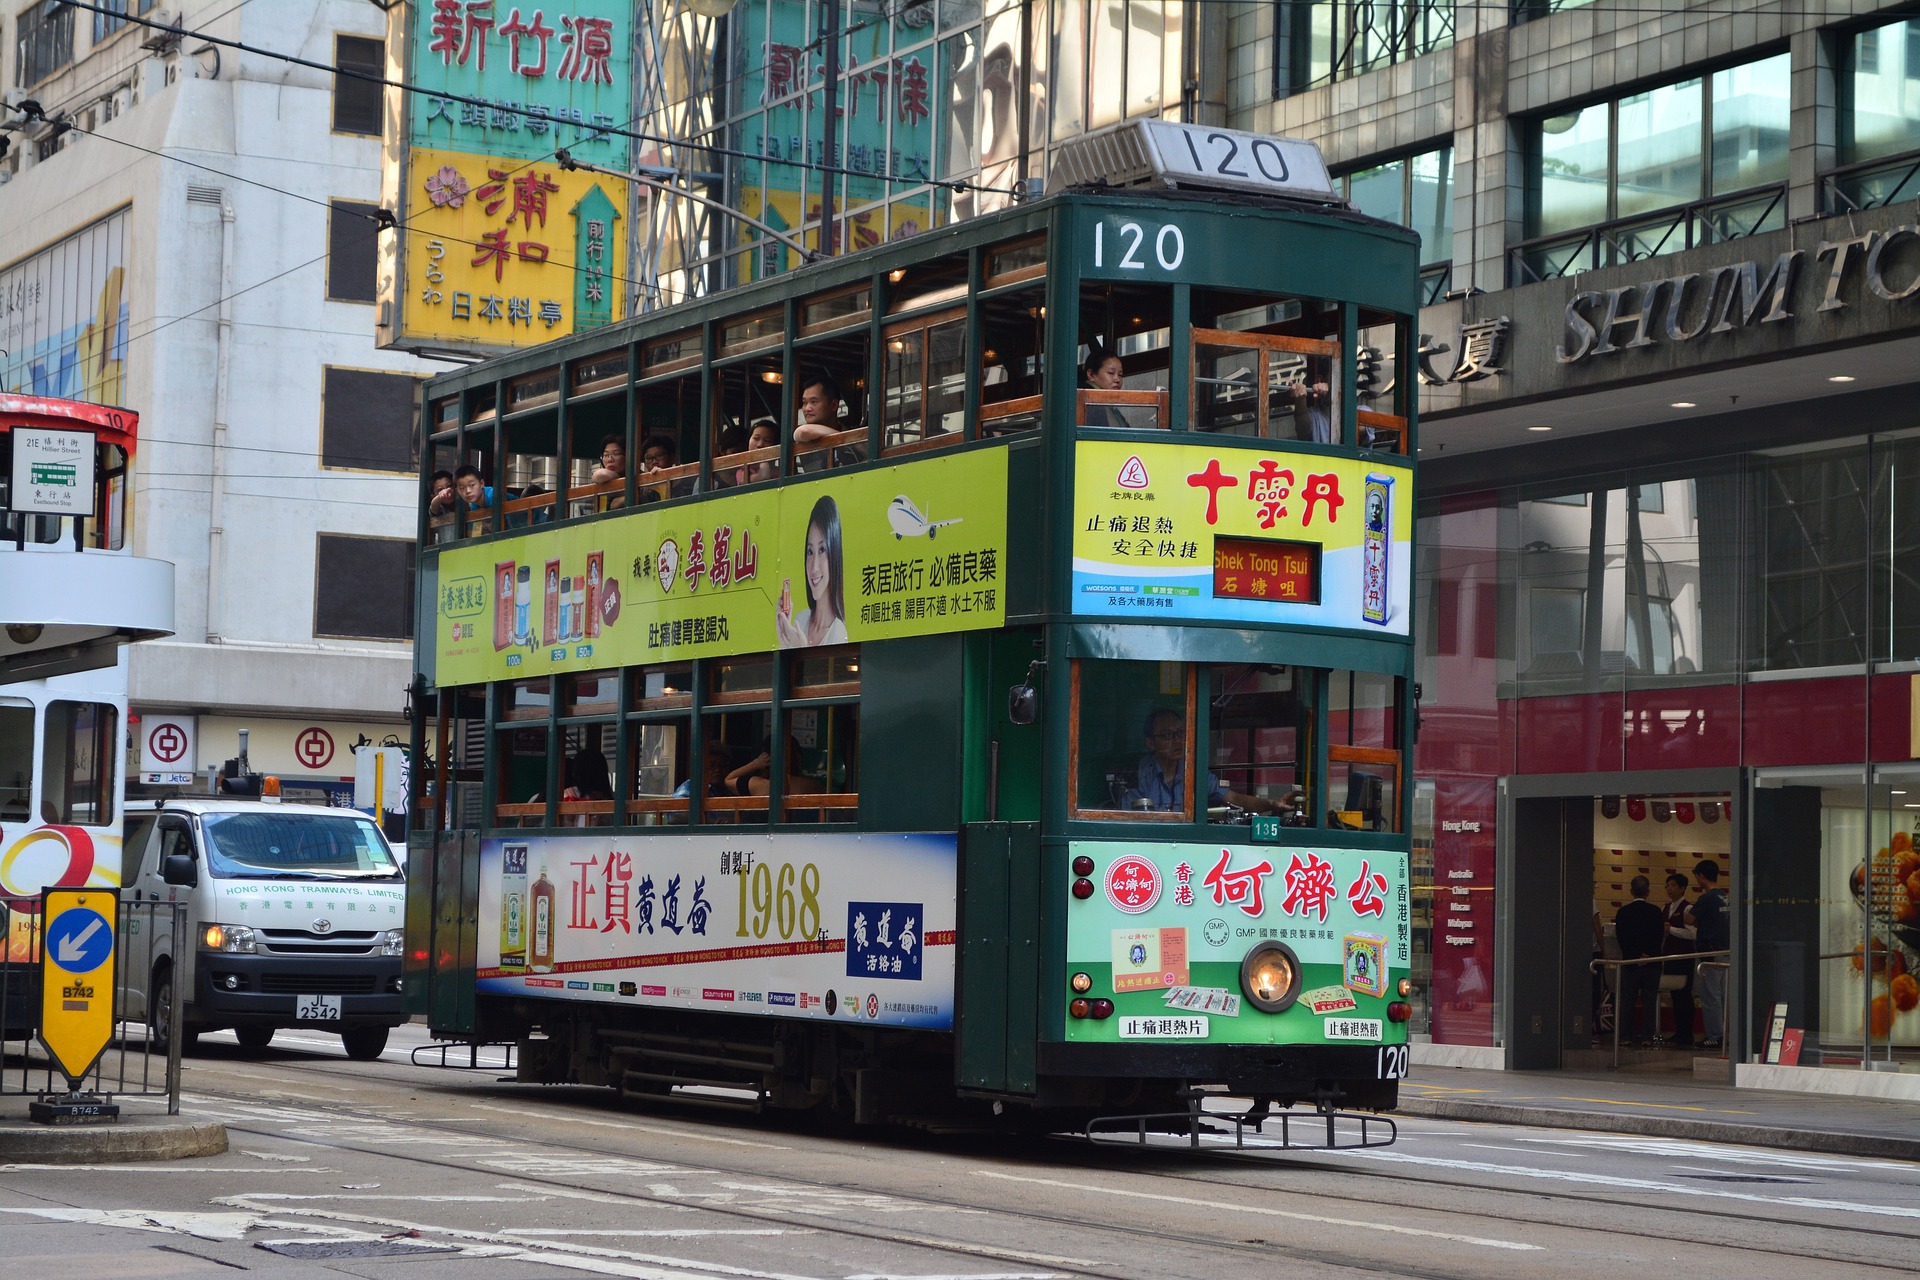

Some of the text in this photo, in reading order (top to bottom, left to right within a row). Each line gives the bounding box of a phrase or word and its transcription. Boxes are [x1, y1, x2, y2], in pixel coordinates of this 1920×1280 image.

[429, 0, 614, 85] 新竹源
[427, 95, 614, 145] 大頭蝦專門店
[1183, 128, 1289, 182] 120
[1095, 221, 1185, 271] 120
[422, 240, 446, 304] うらわ
[452, 290, 563, 328] 日本料亭
[1555, 249, 1805, 364] SHUM
[26, 438, 39, 448] 21E
[1110, 491, 1155, 501] 老牌良藥
[1085, 514, 1174, 534] 止痛退熱
[1111, 539, 1199, 558] 安全快捷
[684, 525, 758, 592] 李萬山
[1215, 550, 1308, 576] Shek Tong Tsui
[861, 548, 997, 597] 家居旅行 必備良藥
[1221, 576, 1298, 597] 石塘咀
[904, 595, 947, 620] 腸胃不適
[950, 589, 996, 616] 水土不服
[1108, 596, 1174, 607] 及各大藥房有售
[648, 615, 729, 649] 肚痛健胃整腸丸
[1255, 823, 1278, 836] 135
[1442, 820, 1480, 833] Hong Kong
[1174, 861, 1194, 905] 香港
[1448, 870, 1474, 879] Australia
[226, 885, 258, 896] HONG
[264, 885, 295, 893] KONG
[367, 889, 404, 901] LIMITED
[567, 851, 633, 935] 正貨
[1203, 848, 1388, 923] 何濟公
[1452, 886, 1469, 895] China
[239, 900, 396, 915] 香港電車有限公司
[736, 862, 820, 941] 1968
[1450, 902, 1471, 912] Macau
[1397, 884, 1408, 960] 香港製造
[1447, 918, 1473, 929] Malaysia
[817, 928, 830, 953] 年
[1236, 928, 1256, 937] GMP
[1445, 935, 1475, 946] Singapore
[867, 955, 902, 973] 活絡油
[63, 987, 94, 999] B742
[311, 995, 329, 1008] JL
[300, 1007, 338, 1019] 2542
[1126, 1019, 1203, 1035] 止痛退熱片
[1329, 1021, 1379, 1038] 止痛退熱散
[1377, 1045, 1408, 1079] 120
[71, 1106, 100, 1116] B742
